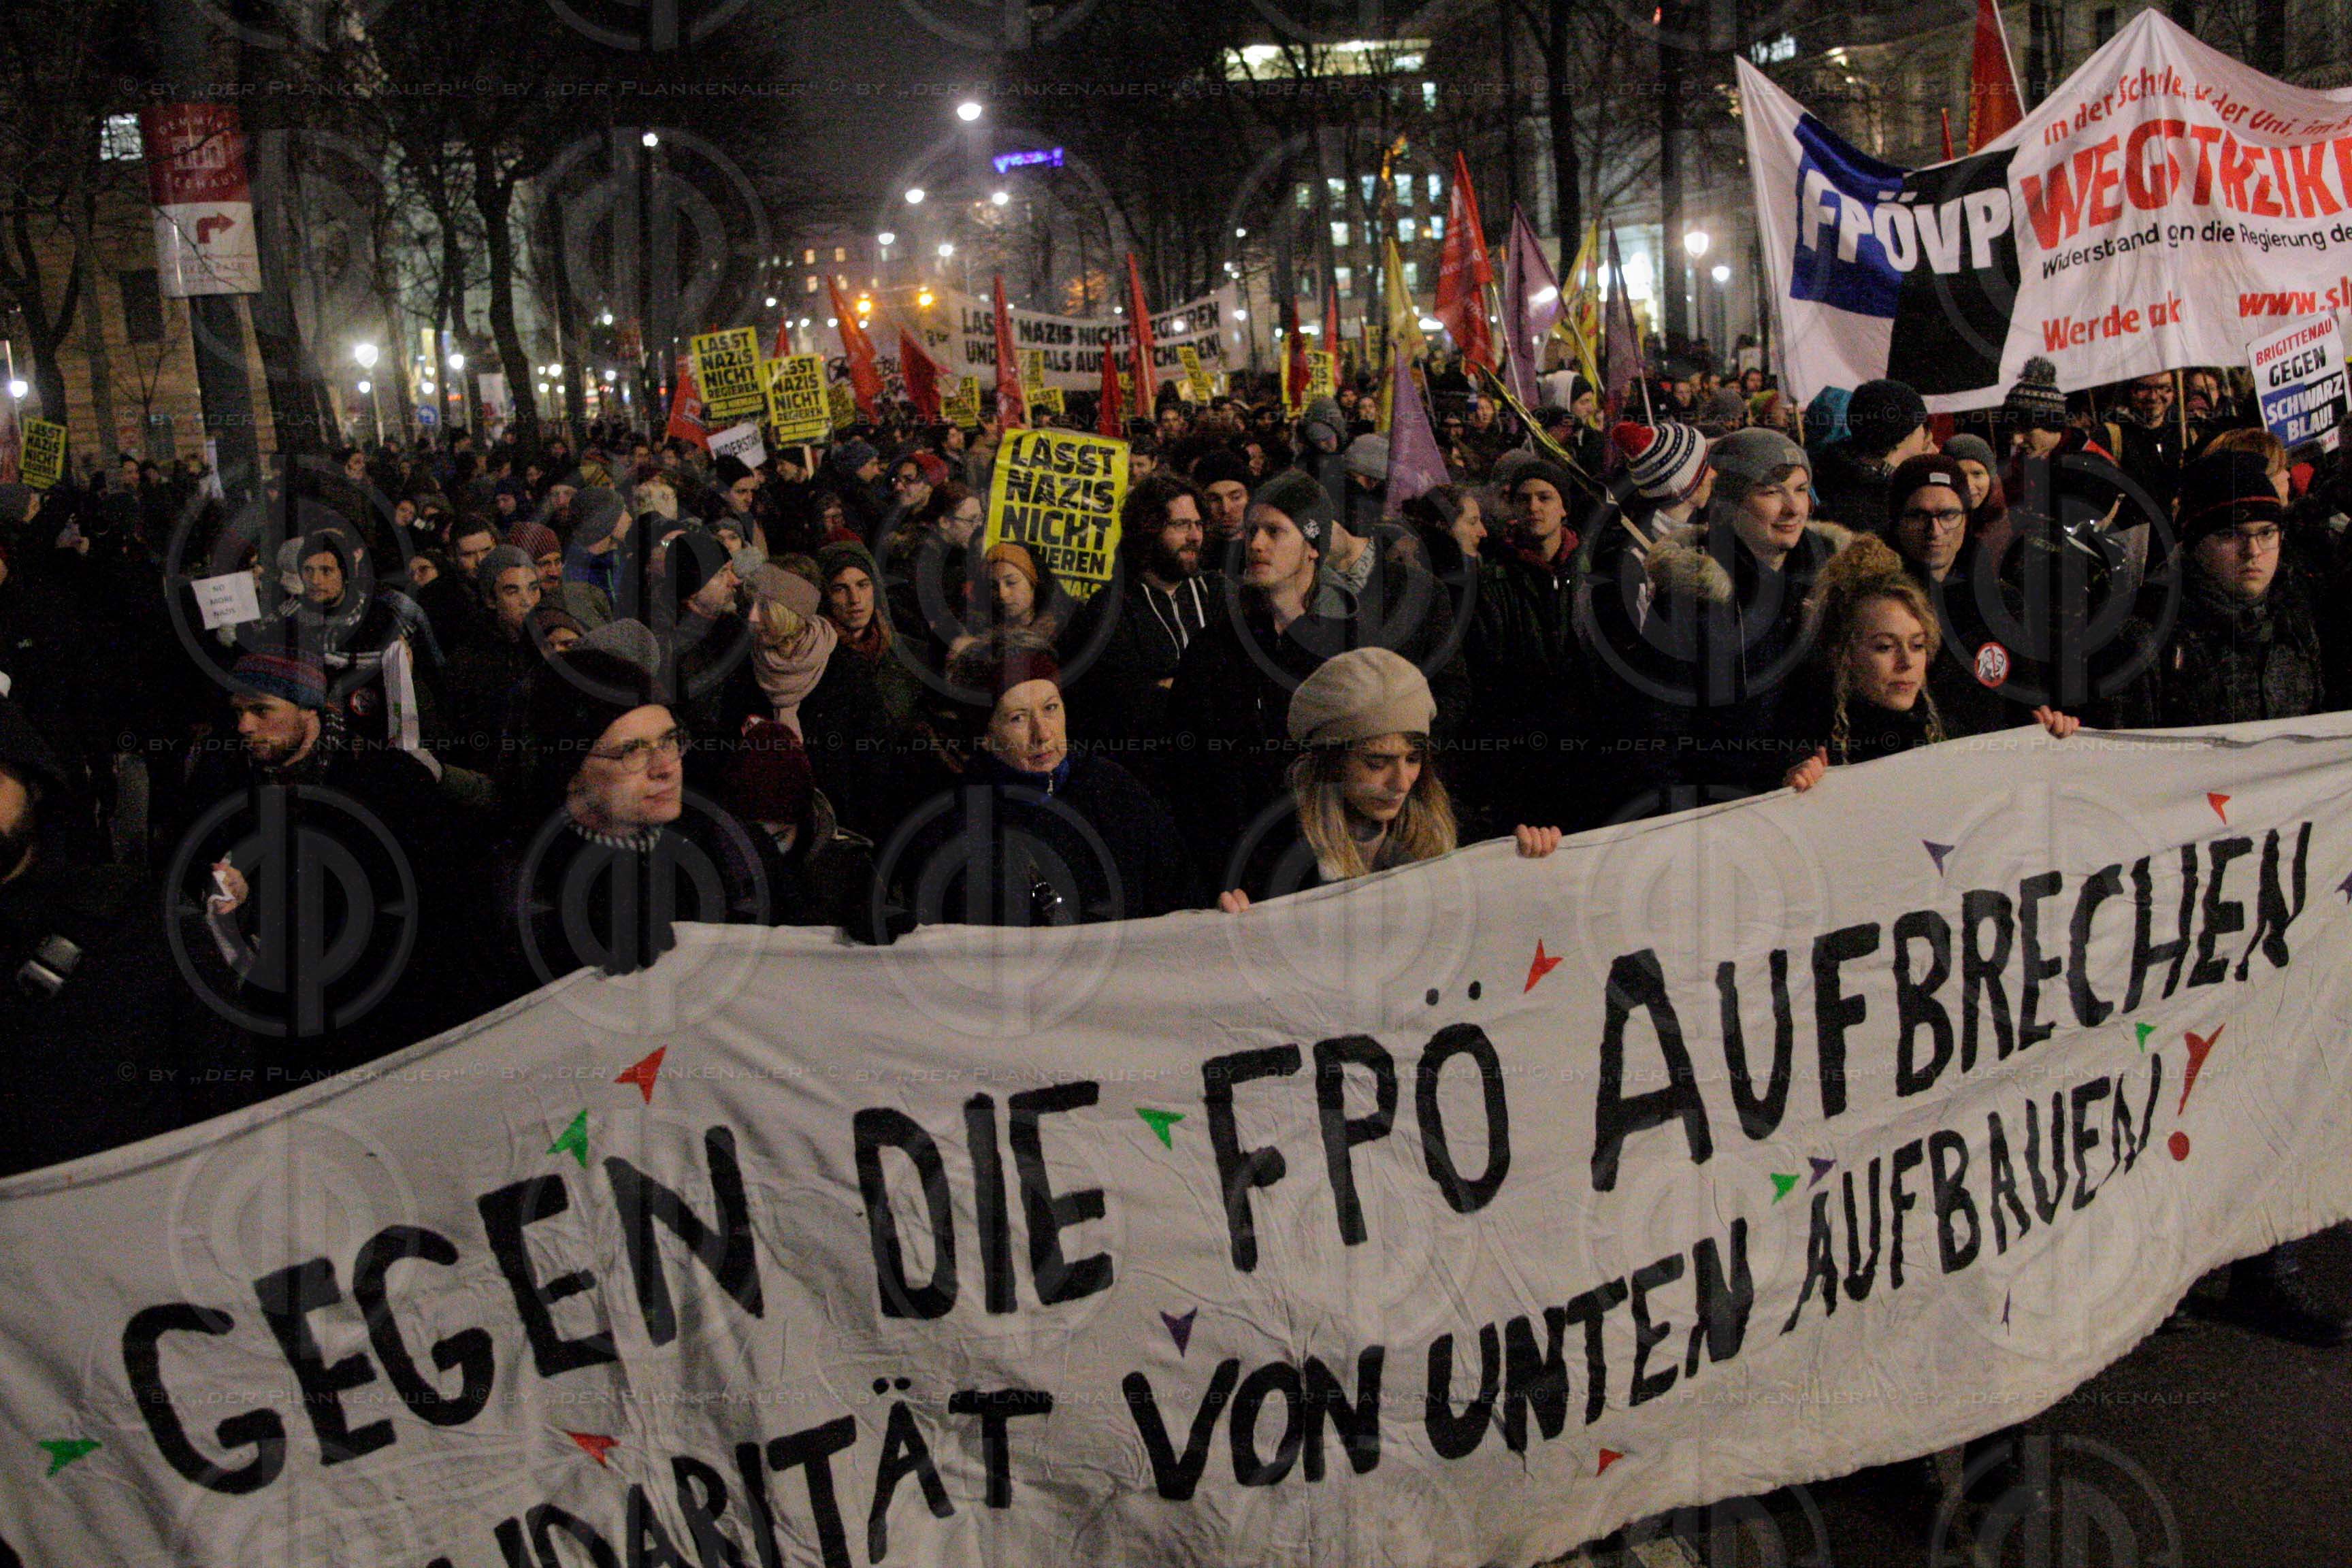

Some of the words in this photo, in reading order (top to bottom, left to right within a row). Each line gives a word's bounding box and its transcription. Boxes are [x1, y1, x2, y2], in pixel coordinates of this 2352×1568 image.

[2074, 103, 2114, 132] der
[2211, 93, 2249, 124] der
[1803, 168, 2012, 274] FPÖVP
[2042, 222, 2161, 279] Widerstand
[2201, 220, 2235, 242] die
[2239, 226, 2328, 254] Regierung
[697, 331, 749, 355] LASST
[1018, 319, 1073, 346] NAZIS
[1078, 326, 1130, 346] NICHT
[2042, 305, 2140, 353] Werde
[2255, 318, 2333, 367] BRIGITTENAU
[700, 348, 753, 371] NAZIS
[704, 365, 756, 389] NICHT
[2269, 344, 2327, 388] GEGEN
[771, 374, 818, 394] NAZIS
[774, 390, 821, 409] NICHT
[2266, 374, 2344, 426] SCHWARZ
[2287, 403, 2334, 442] BLAU!
[1011, 435, 1116, 477] LASST
[1006, 468, 1115, 514] NAZIS
[1000, 504, 1112, 551] NICHT
[122, 1125, 764, 1495] GEGEN
[853, 1079, 1114, 1320] DIE
[1202, 980, 1512, 1273] FPÖ
[1590, 821, 2313, 1192] AUFBRECHEN
[1121, 1344, 1385, 1502] VON
[1424, 1218, 1754, 1460] UNTEN
